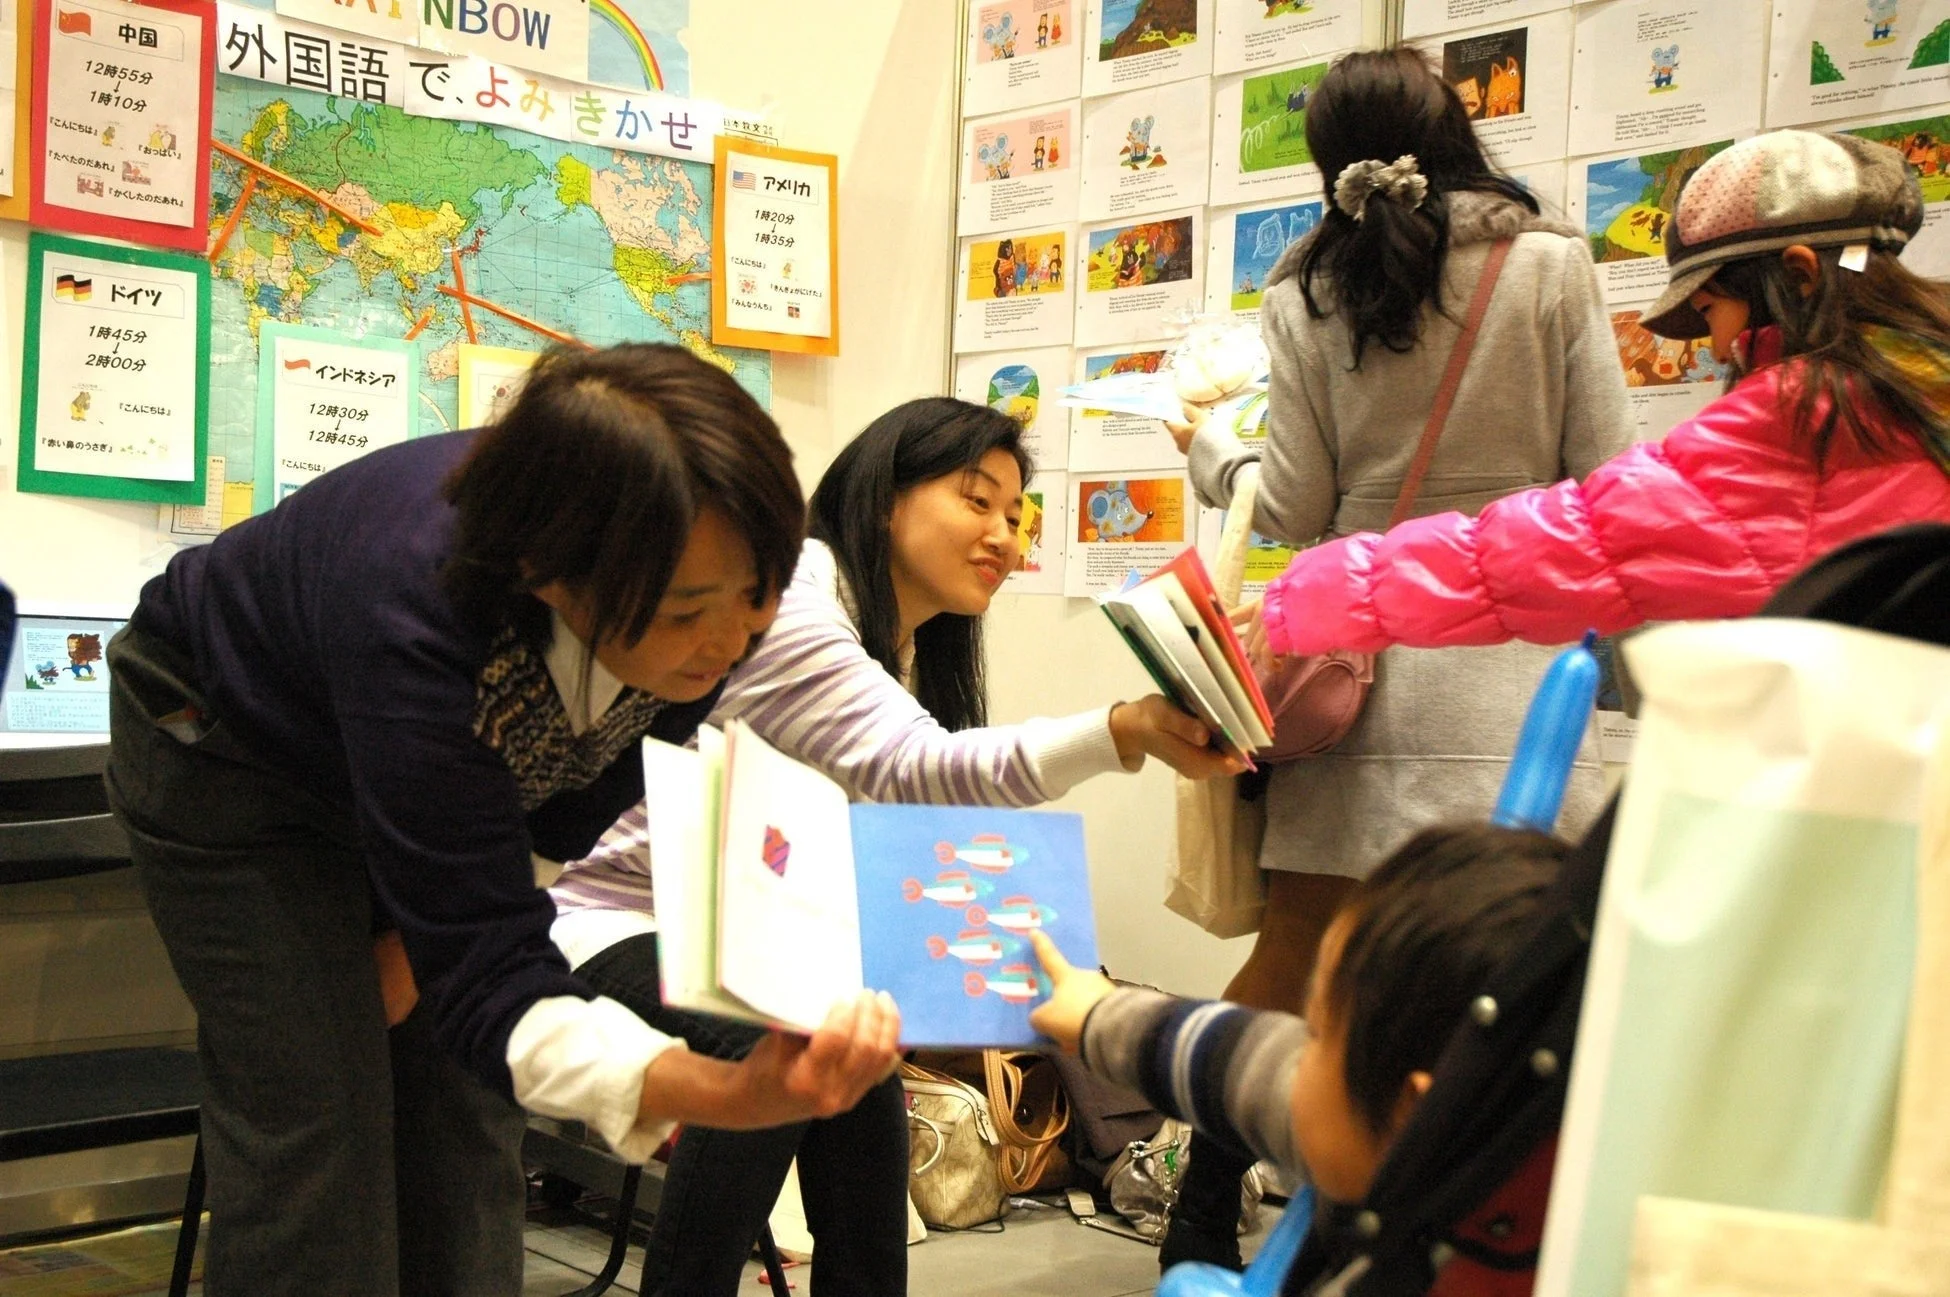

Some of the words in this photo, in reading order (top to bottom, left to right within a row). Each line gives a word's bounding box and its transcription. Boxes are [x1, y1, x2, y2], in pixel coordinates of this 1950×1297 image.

[333, 0, 551, 50] NBOW
[118, 24, 159, 48] 中国
[85, 60, 154, 85] 12時55分
[225, 23, 697, 151] 外国語で、よみきかせ
[89, 90, 147, 113] 1時10分
[49, 117, 98, 136] 『こんにちは』
[763, 175, 811, 197] アメリカ
[755, 209, 795, 225] 1時20分
[755, 232, 795, 248] 1時35分
[110, 284, 162, 306] ドイツ
[88, 325, 147, 344] 1時45分
[85, 353, 147, 373] 2時00分
[315, 365, 396, 388] インドネシア
[119, 402, 171, 417] 『こんにちは』
[309, 402, 369, 422] 12時30分
[42, 437, 113, 454] 『赤い鼻のうさぎ』
[308, 430, 368, 449] 12時45分
